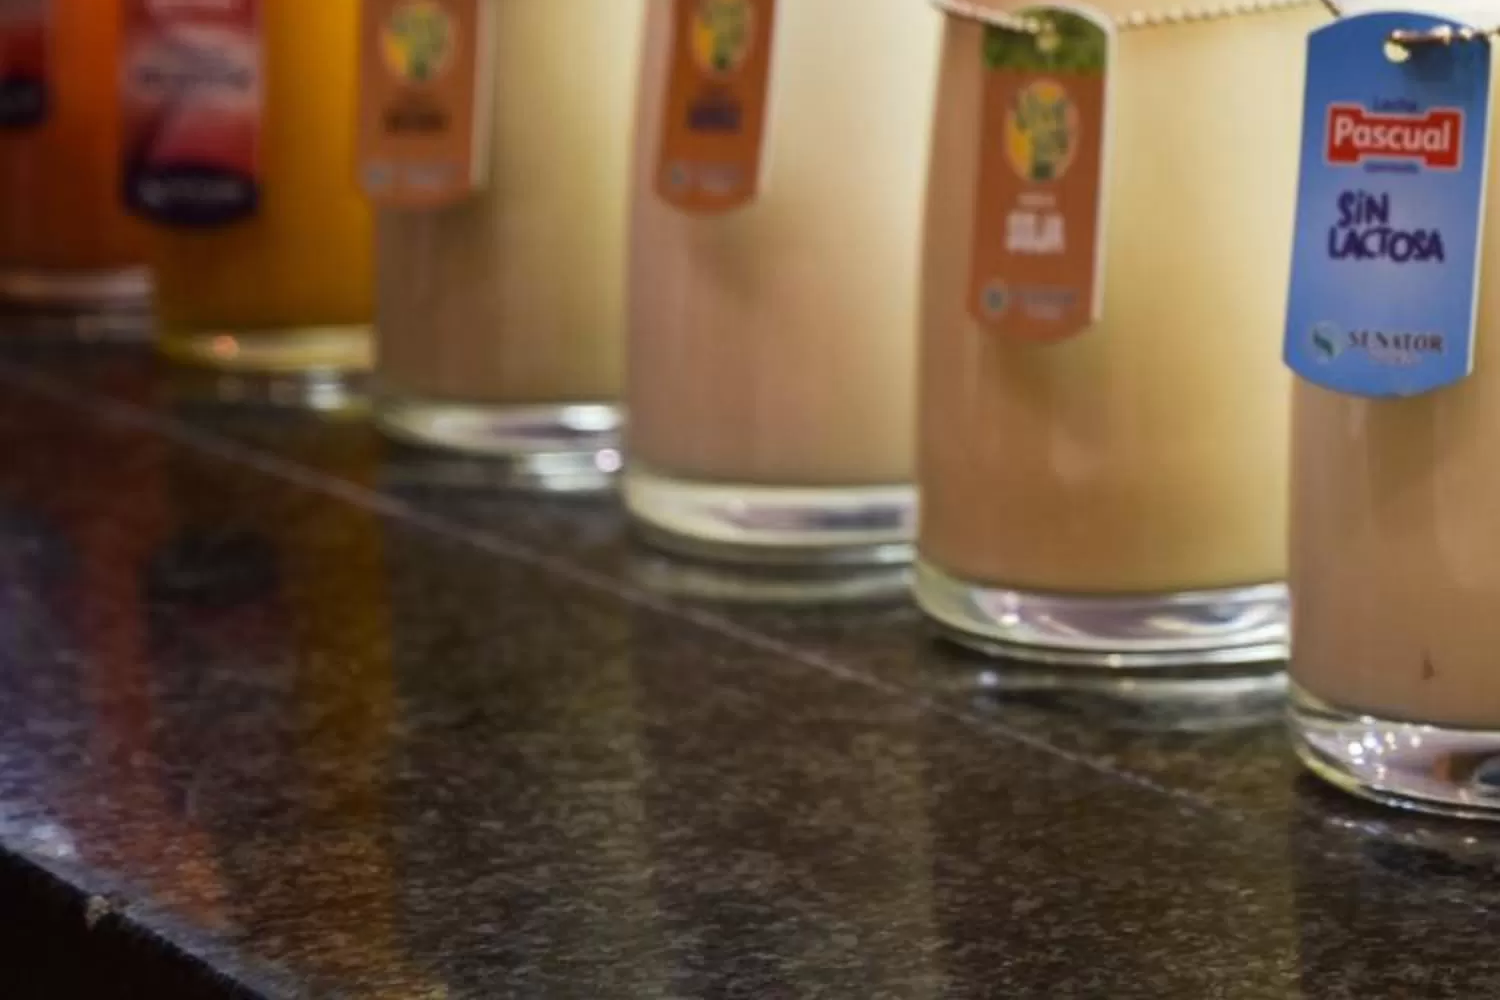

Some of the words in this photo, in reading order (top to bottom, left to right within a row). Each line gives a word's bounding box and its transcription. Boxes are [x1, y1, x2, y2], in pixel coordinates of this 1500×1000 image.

[1333, 114, 1451, 152] Pascual
[1328, 227, 1444, 263] LACTOSA
[1348, 330, 1445, 356] SENATOR
